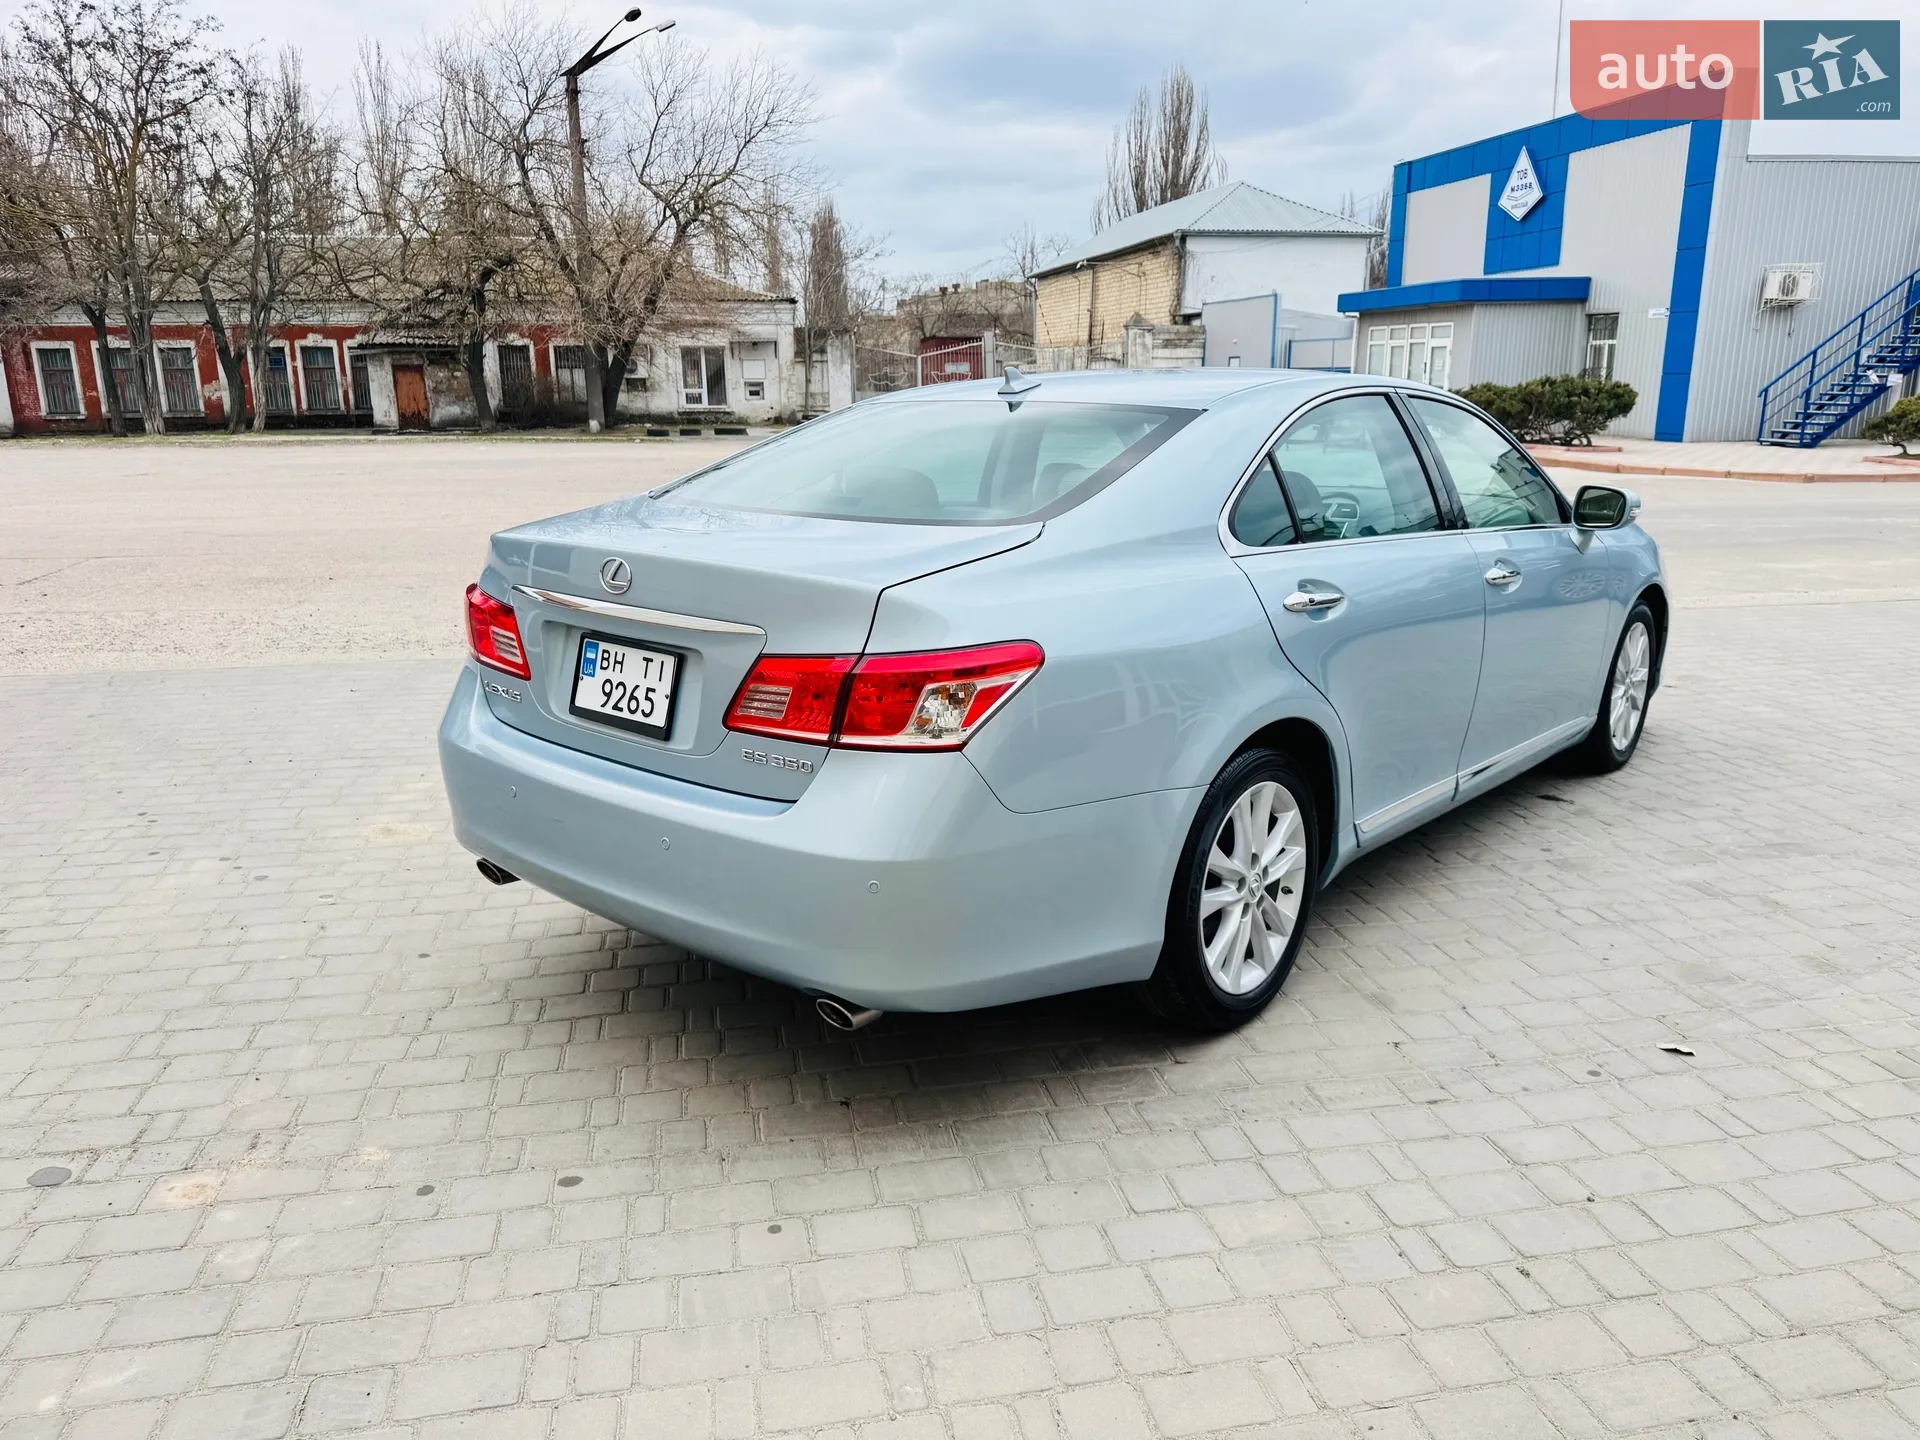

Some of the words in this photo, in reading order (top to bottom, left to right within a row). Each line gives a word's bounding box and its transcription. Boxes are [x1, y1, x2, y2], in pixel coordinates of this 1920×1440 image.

[583, 662, 594, 675] UA
[600, 649, 625, 673] BH
[642, 656, 664, 682] TI
[484, 680, 522, 703] LEXUS
[600, 678, 656, 718] 9265
[741, 748, 768, 765] ES
[770, 754, 813, 774] 350
